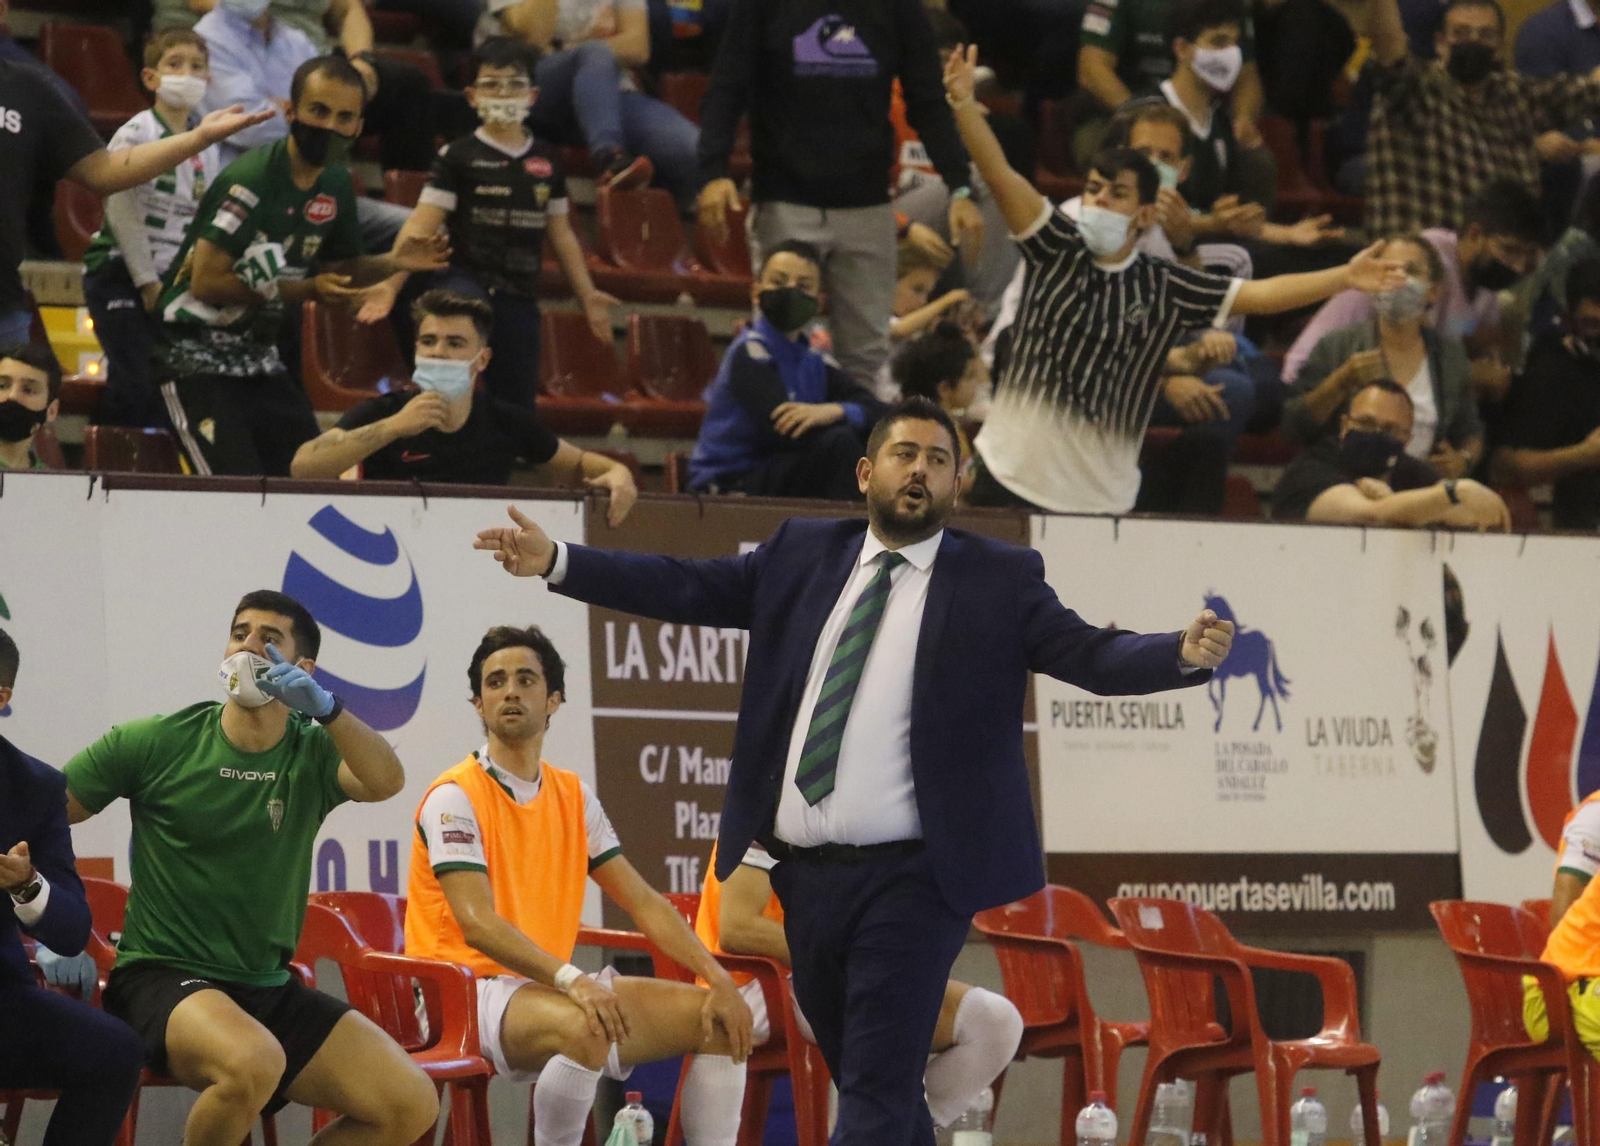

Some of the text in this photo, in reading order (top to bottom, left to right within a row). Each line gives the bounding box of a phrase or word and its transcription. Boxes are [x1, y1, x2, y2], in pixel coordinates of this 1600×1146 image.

[605, 621, 650, 680] LA
[1050, 700, 1186, 730] PUERTA SEVILLA
[1304, 716, 1394, 747] LA VIUDA
[220, 767, 276, 781] GIVOVA
[639, 744, 733, 785] C/ Man
[674, 801, 721, 839] Plaz
